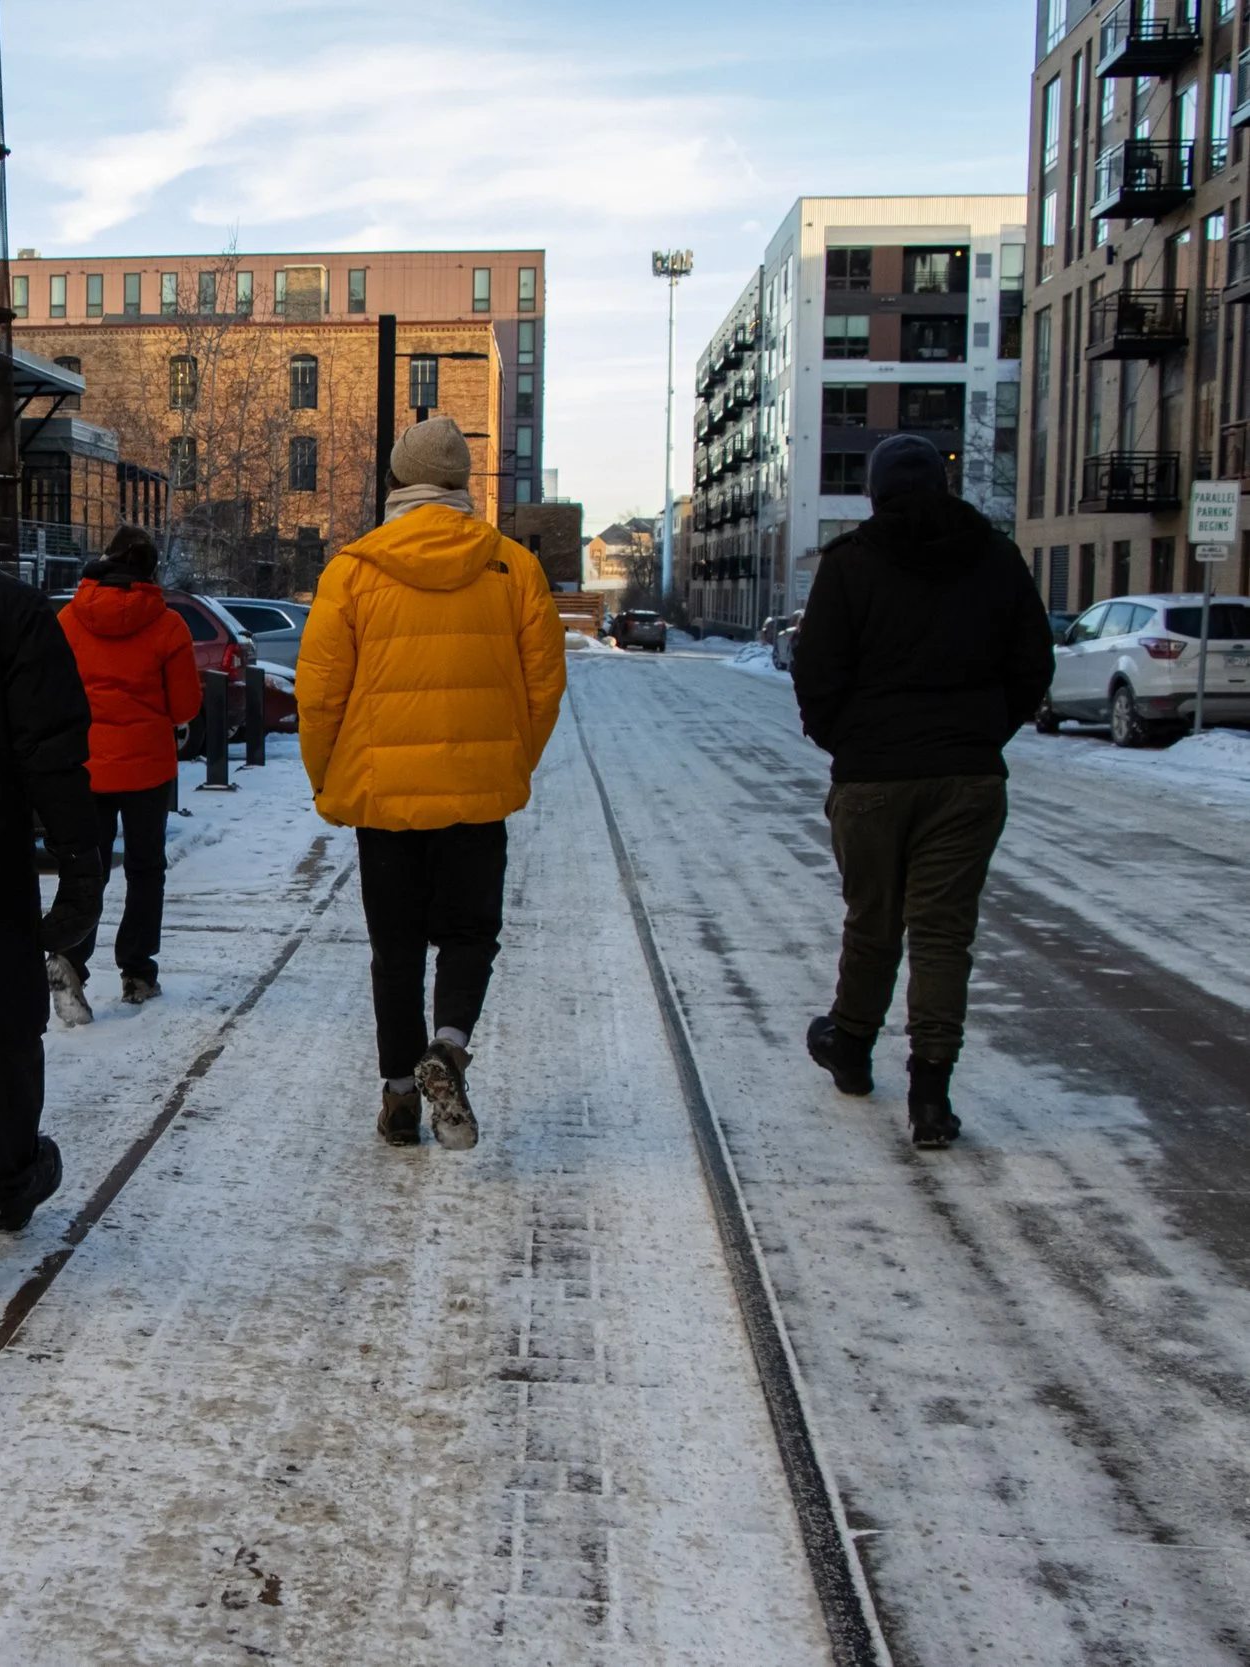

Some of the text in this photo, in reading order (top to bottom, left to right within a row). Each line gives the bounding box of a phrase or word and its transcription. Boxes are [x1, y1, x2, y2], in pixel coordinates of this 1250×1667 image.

[1195, 493, 1236, 503] PARALLEL
[1197, 507, 1233, 517] PARKING
[1199, 521, 1229, 531] BEGINS
